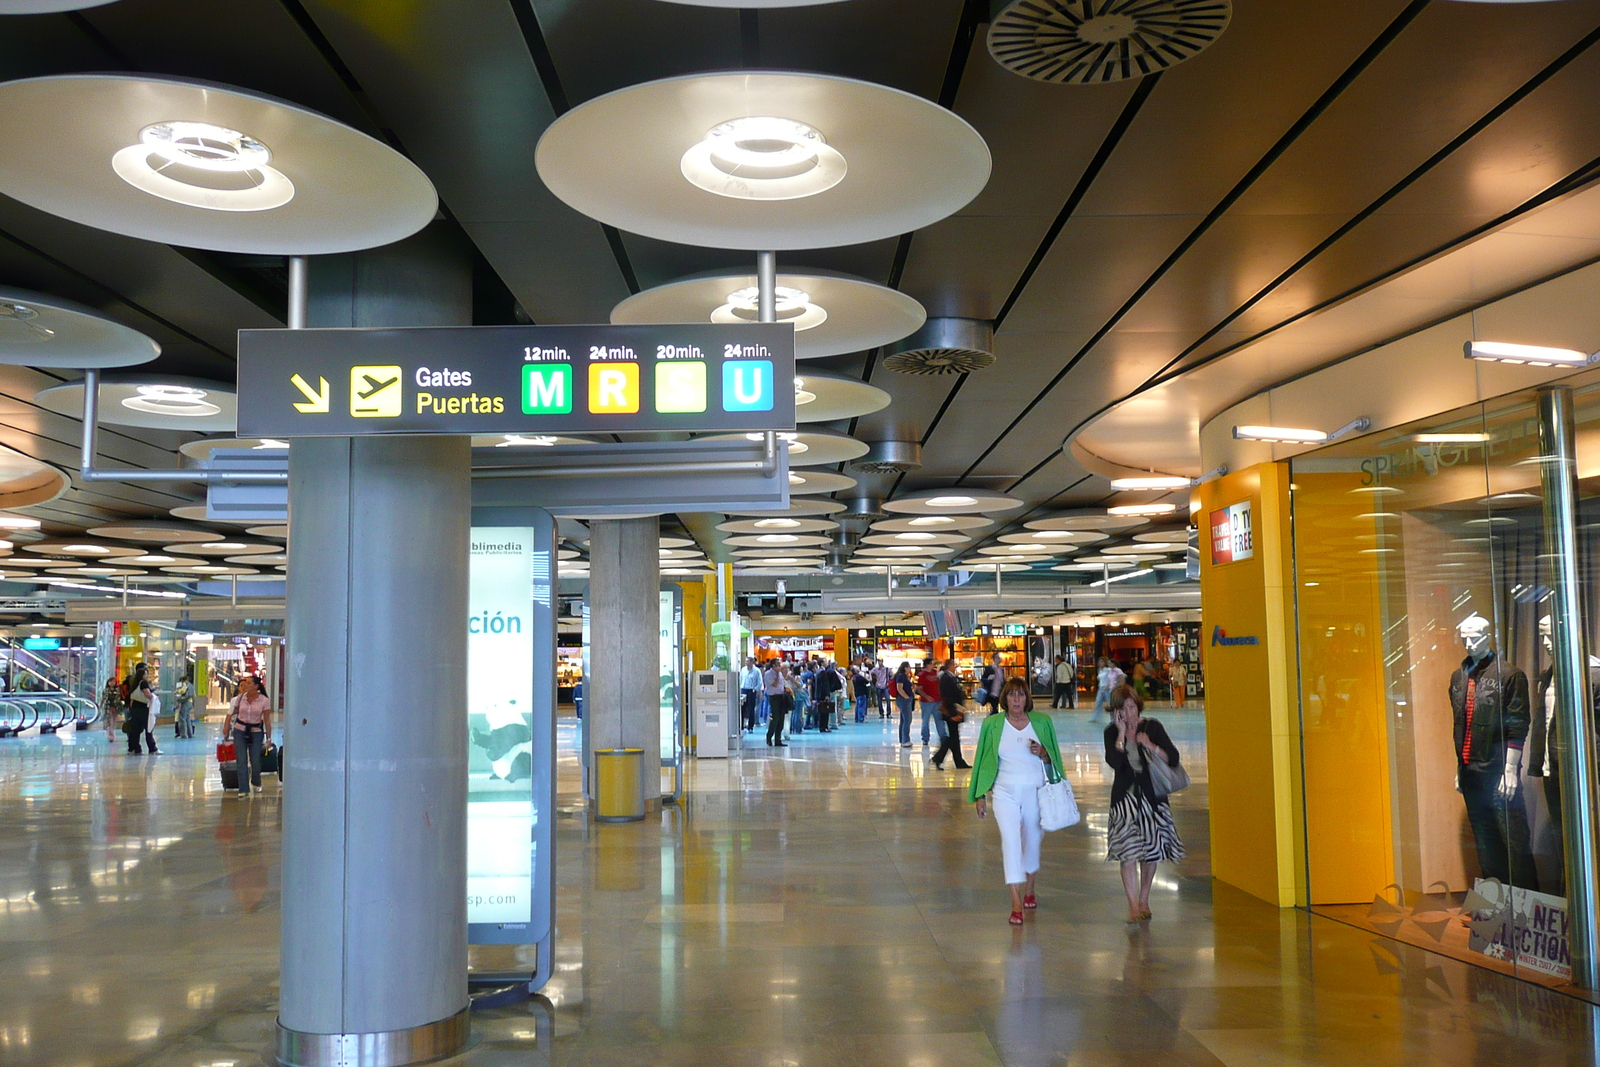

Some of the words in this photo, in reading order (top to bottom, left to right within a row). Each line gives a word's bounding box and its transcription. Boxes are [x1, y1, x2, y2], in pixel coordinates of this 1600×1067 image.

[415, 366, 472, 387] Gates
[530, 371, 564, 407] M
[599, 369, 628, 407] R
[667, 367, 697, 406] S
[734, 367, 762, 404] U
[417, 392, 505, 414] Puertas
[1234, 531, 1252, 553] FREE
[469, 610, 521, 634] ción
